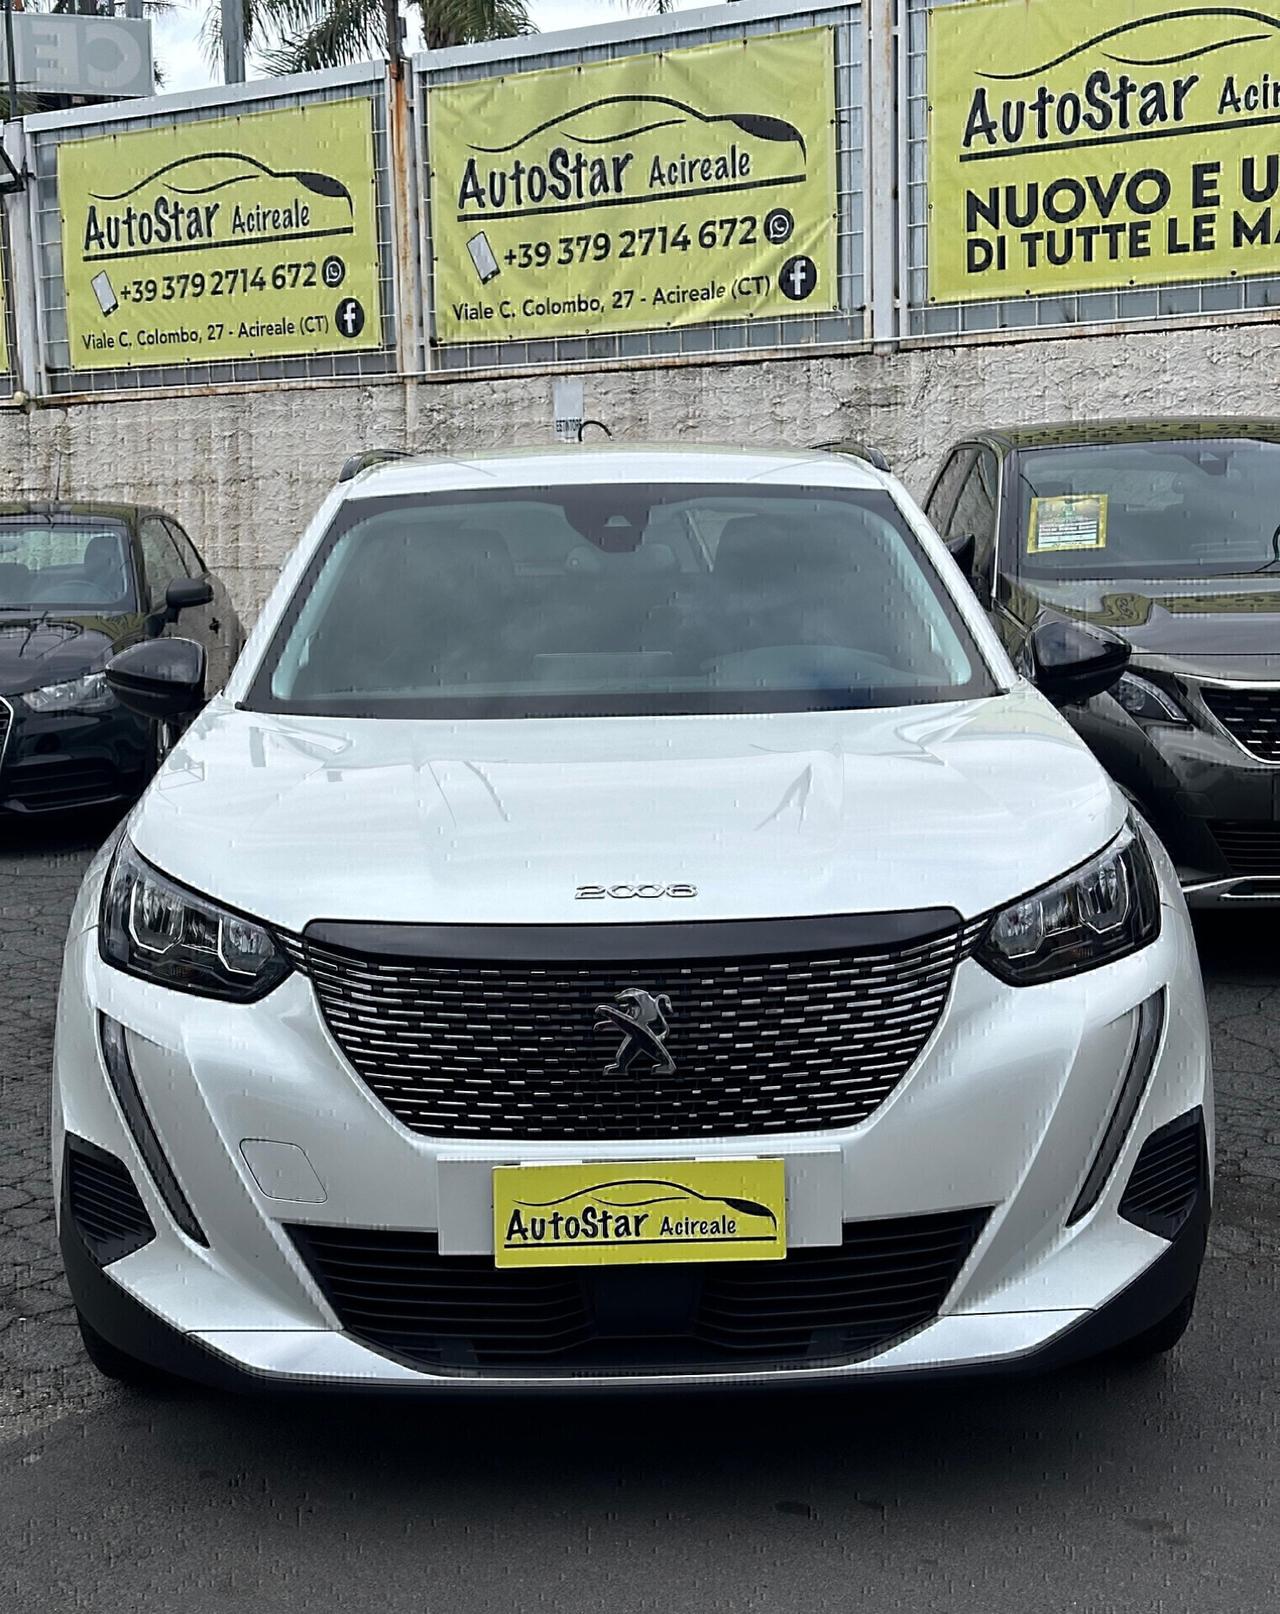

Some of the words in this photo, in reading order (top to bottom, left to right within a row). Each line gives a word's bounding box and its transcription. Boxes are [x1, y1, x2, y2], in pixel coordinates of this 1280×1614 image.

[962, 70, 1199, 147] AutoStar
[457, 147, 633, 209] AutoStar
[649, 145, 750, 188] Acireale
[966, 168, 1171, 232] NUOVO
[1192, 161, 1221, 208] E
[83, 196, 220, 251] AutoStar
[232, 198, 311, 234] Acireale
[503, 241, 552, 269] +39
[557, 232, 611, 265] 379
[618, 223, 691, 259] 2714
[698, 215, 757, 249] 672
[967, 236, 1006, 273] DI
[1020, 220, 1151, 267] TUTTE
[1168, 213, 1216, 254] LE
[1233, 206, 1280, 248] M
[120, 279, 158, 303] +39
[161, 272, 206, 301] 379
[210, 266, 267, 296] 2714
[271, 261, 317, 290] 672
[452, 301, 494, 322] Viale
[499, 300, 516, 319] C.
[522, 292, 606, 317] Colombo,
[611, 290, 635, 310] 27
[652, 280, 726, 306] Acireale
[731, 274, 771, 301] (CT)
[81, 331, 115, 351] Viale
[118, 331, 133, 348] C.
[136, 325, 203, 346] Colombo,
[207, 323, 224, 341] 27
[237, 317, 296, 339] Acireale
[299, 315, 329, 336] (CT)
[574, 884, 698, 900] 2008
[506, 1206, 649, 1241] AutoStar
[660, 1215, 736, 1236] Acireale
